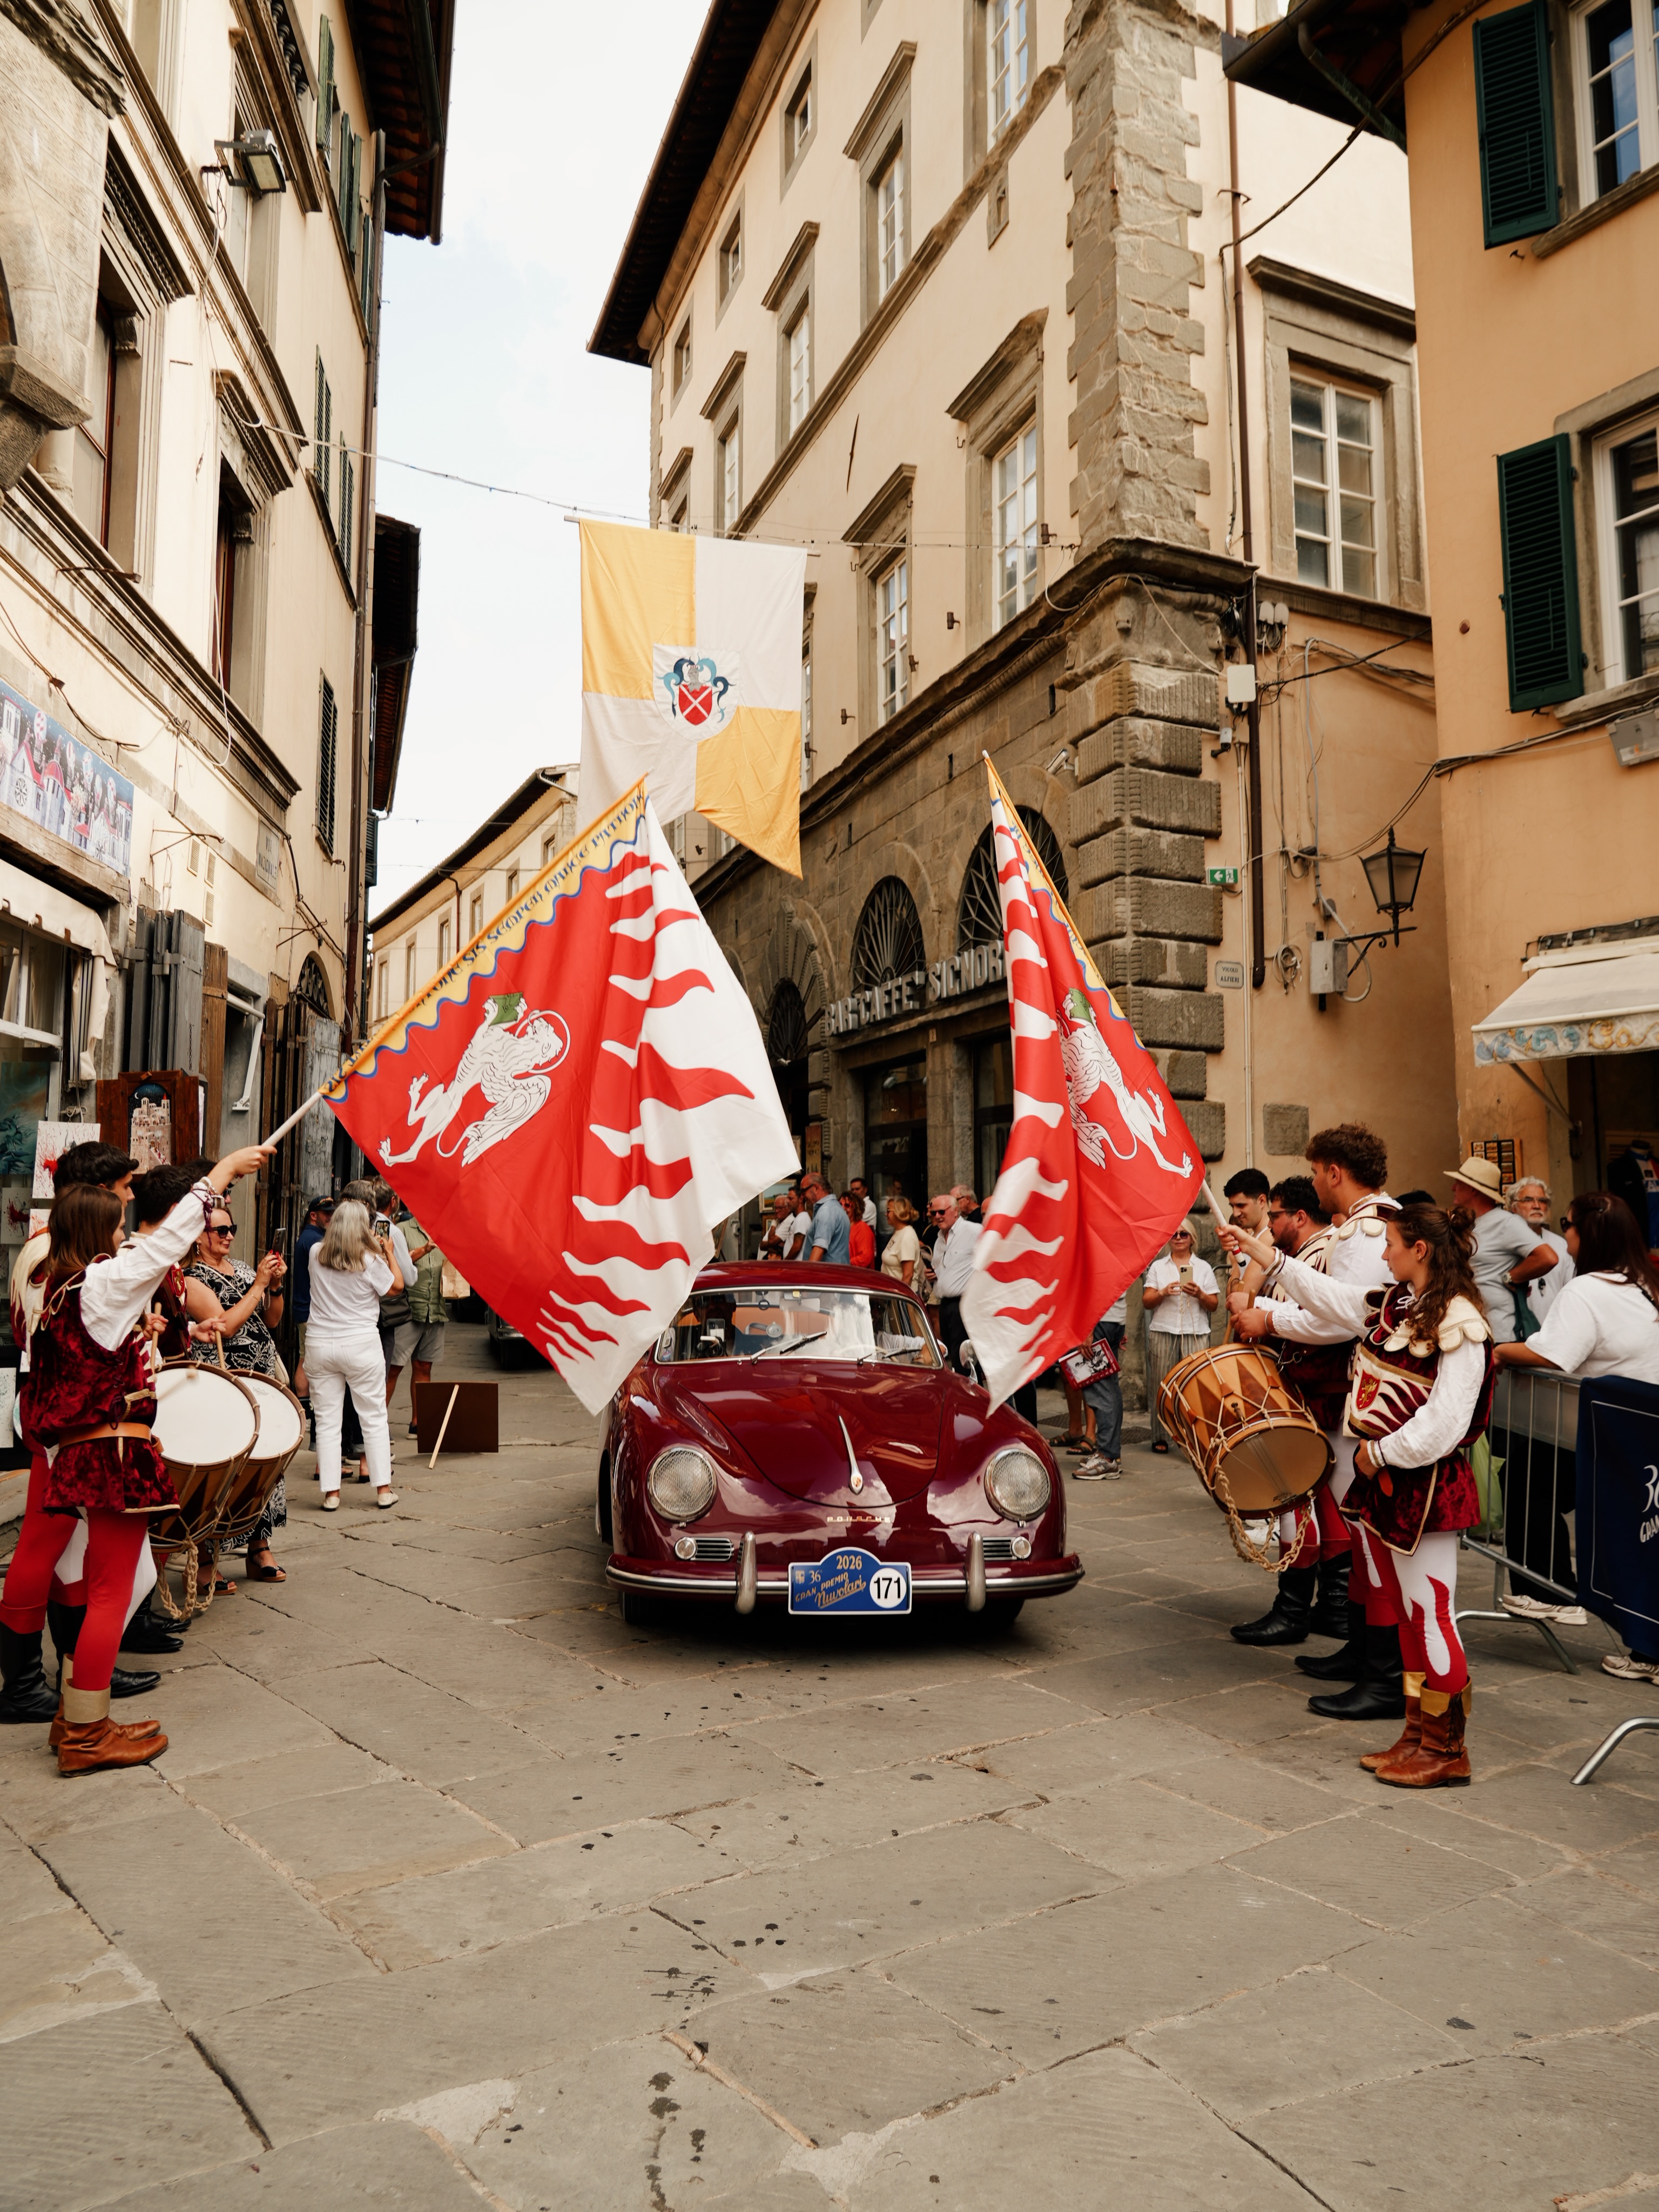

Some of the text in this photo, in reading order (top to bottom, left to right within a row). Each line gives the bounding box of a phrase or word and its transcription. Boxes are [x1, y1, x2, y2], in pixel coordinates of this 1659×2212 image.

[488, 891, 544, 944] SEMPER
[825, 997, 858, 1037] BAR
[928, 940, 1007, 1001] SIGNOR
[837, 1555, 862, 1570] 2026
[795, 1572, 849, 1602] GRAN PREMIO
[814, 1575, 867, 1609] Nuvolari
[874, 1577, 901, 1599] 171
